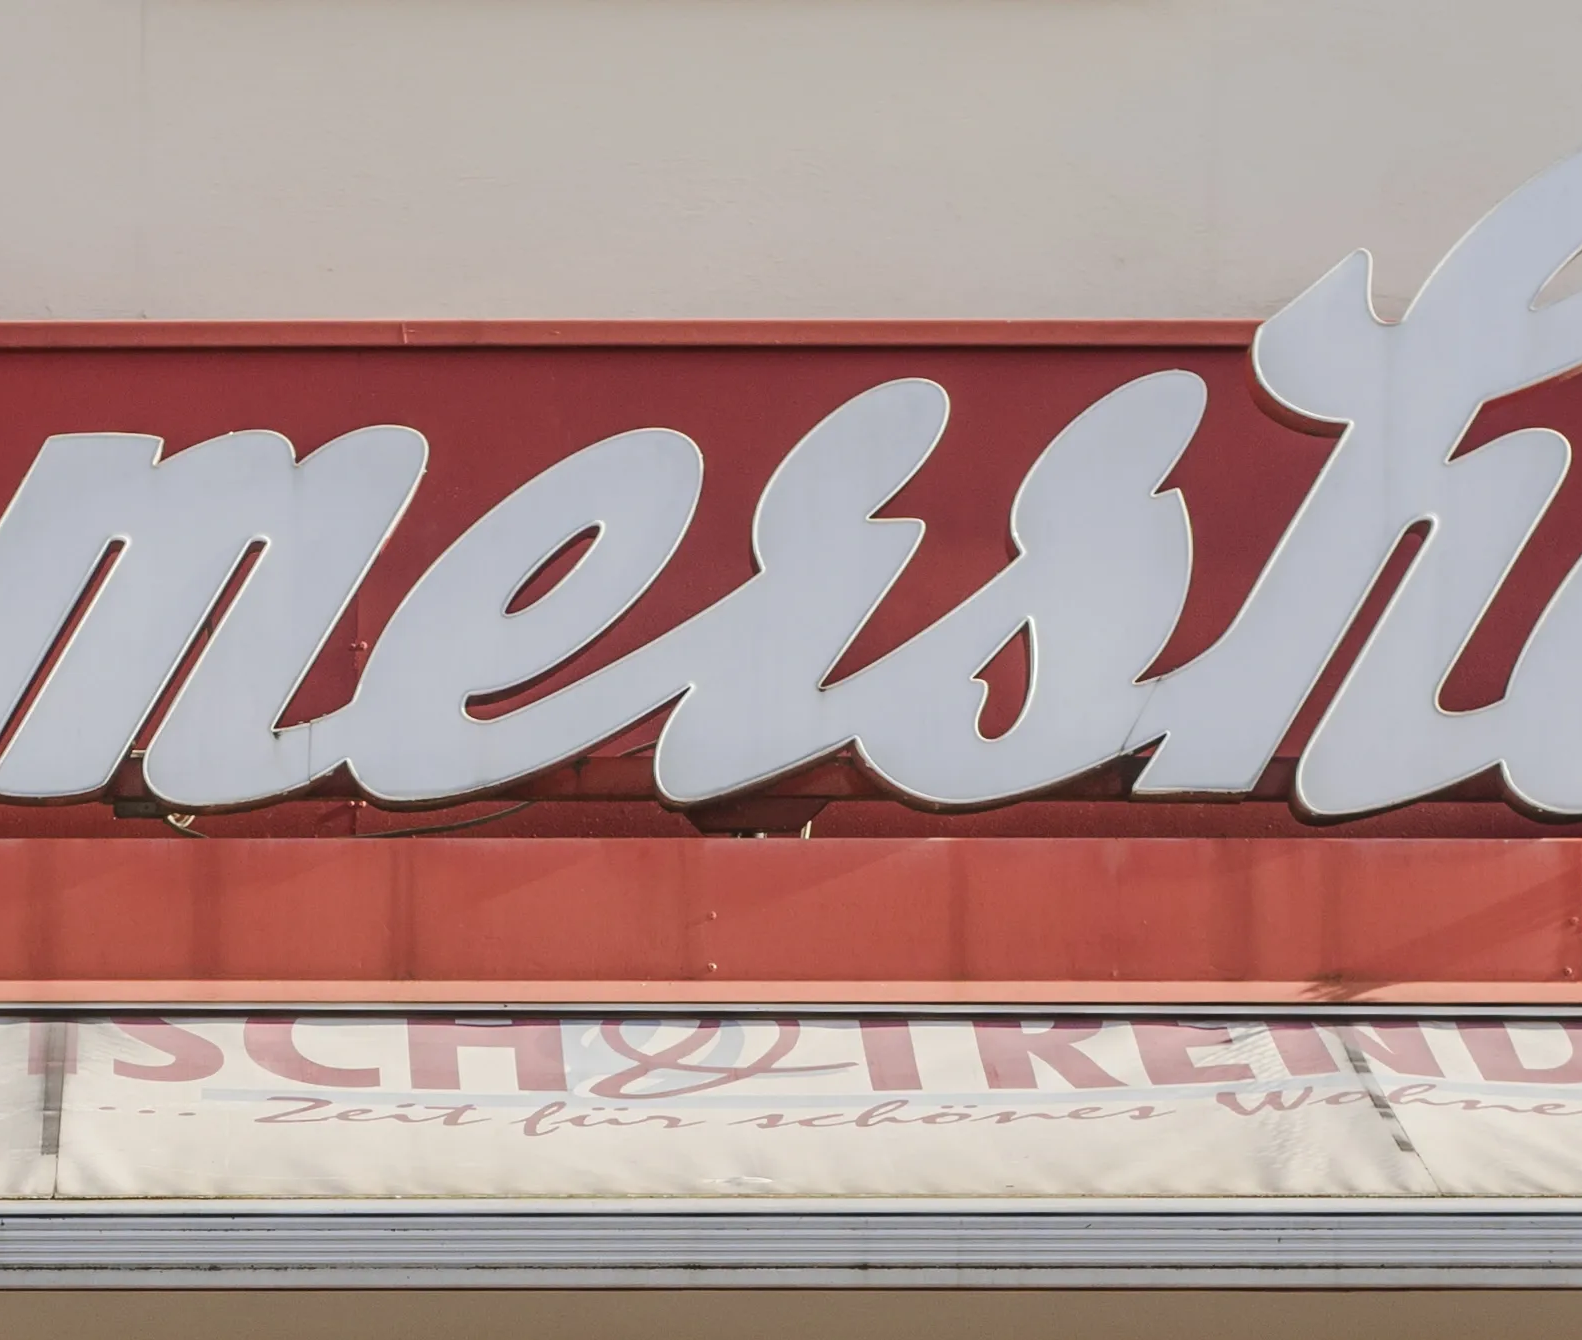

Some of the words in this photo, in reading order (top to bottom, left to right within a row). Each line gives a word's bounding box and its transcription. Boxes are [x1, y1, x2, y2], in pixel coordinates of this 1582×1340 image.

[253, 1095, 492, 1127] Zeit
[510, 1100, 706, 1137] für
[728, 1099, 1176, 1130] schönes
